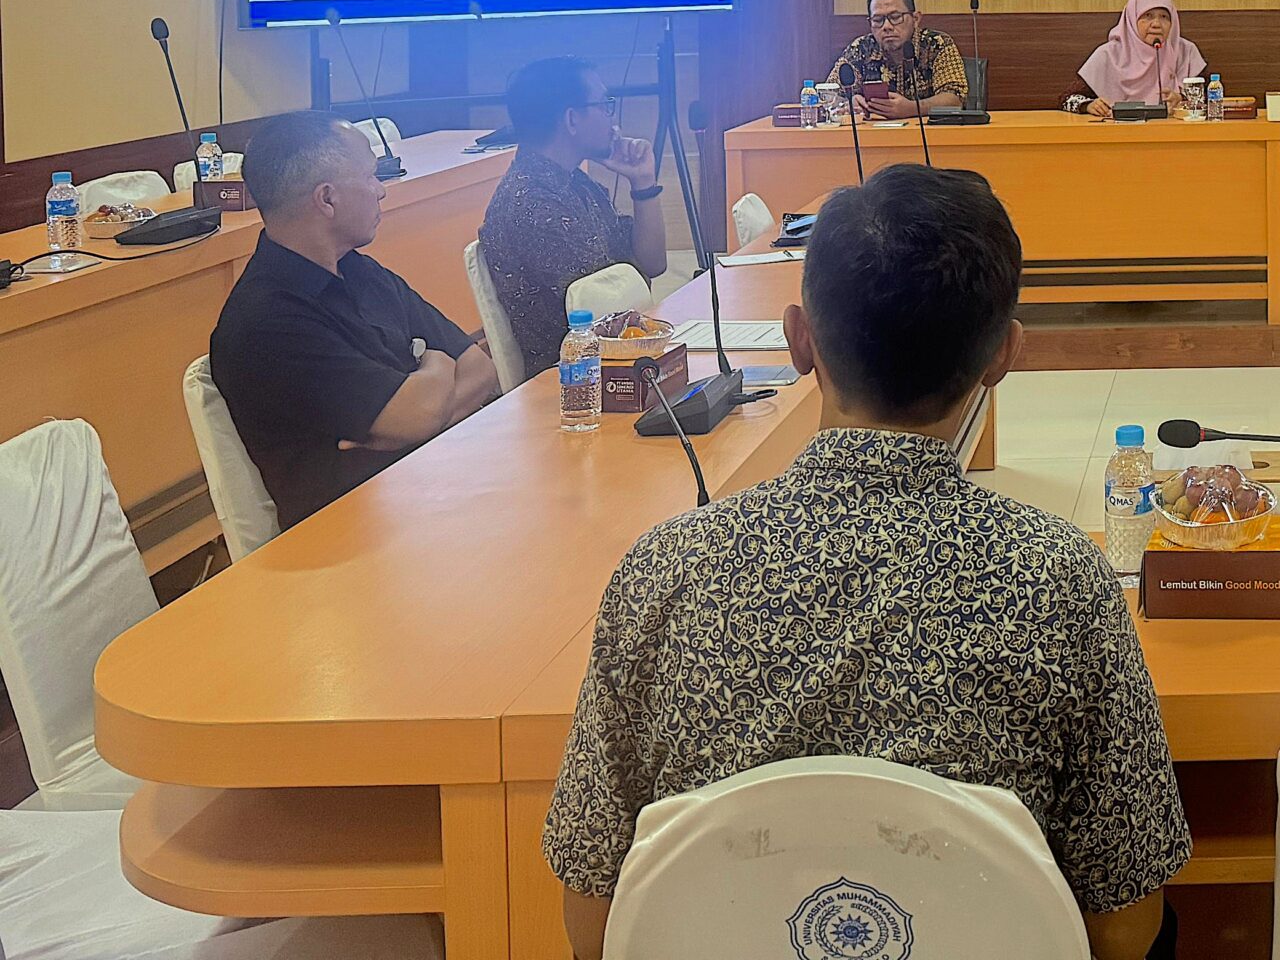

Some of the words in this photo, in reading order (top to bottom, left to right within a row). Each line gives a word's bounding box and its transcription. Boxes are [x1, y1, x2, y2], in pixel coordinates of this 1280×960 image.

[1109, 495, 1134, 506] QMAS
[1160, 580, 1197, 590] Lembut
[1199, 580, 1223, 590] Bikin
[1225, 580, 1251, 590] Good
[1254, 580, 1280, 590] Mood
[803, 895, 834, 946] UNIVERSITAS
[837, 892, 902, 942] MUHAMMADIYAH
